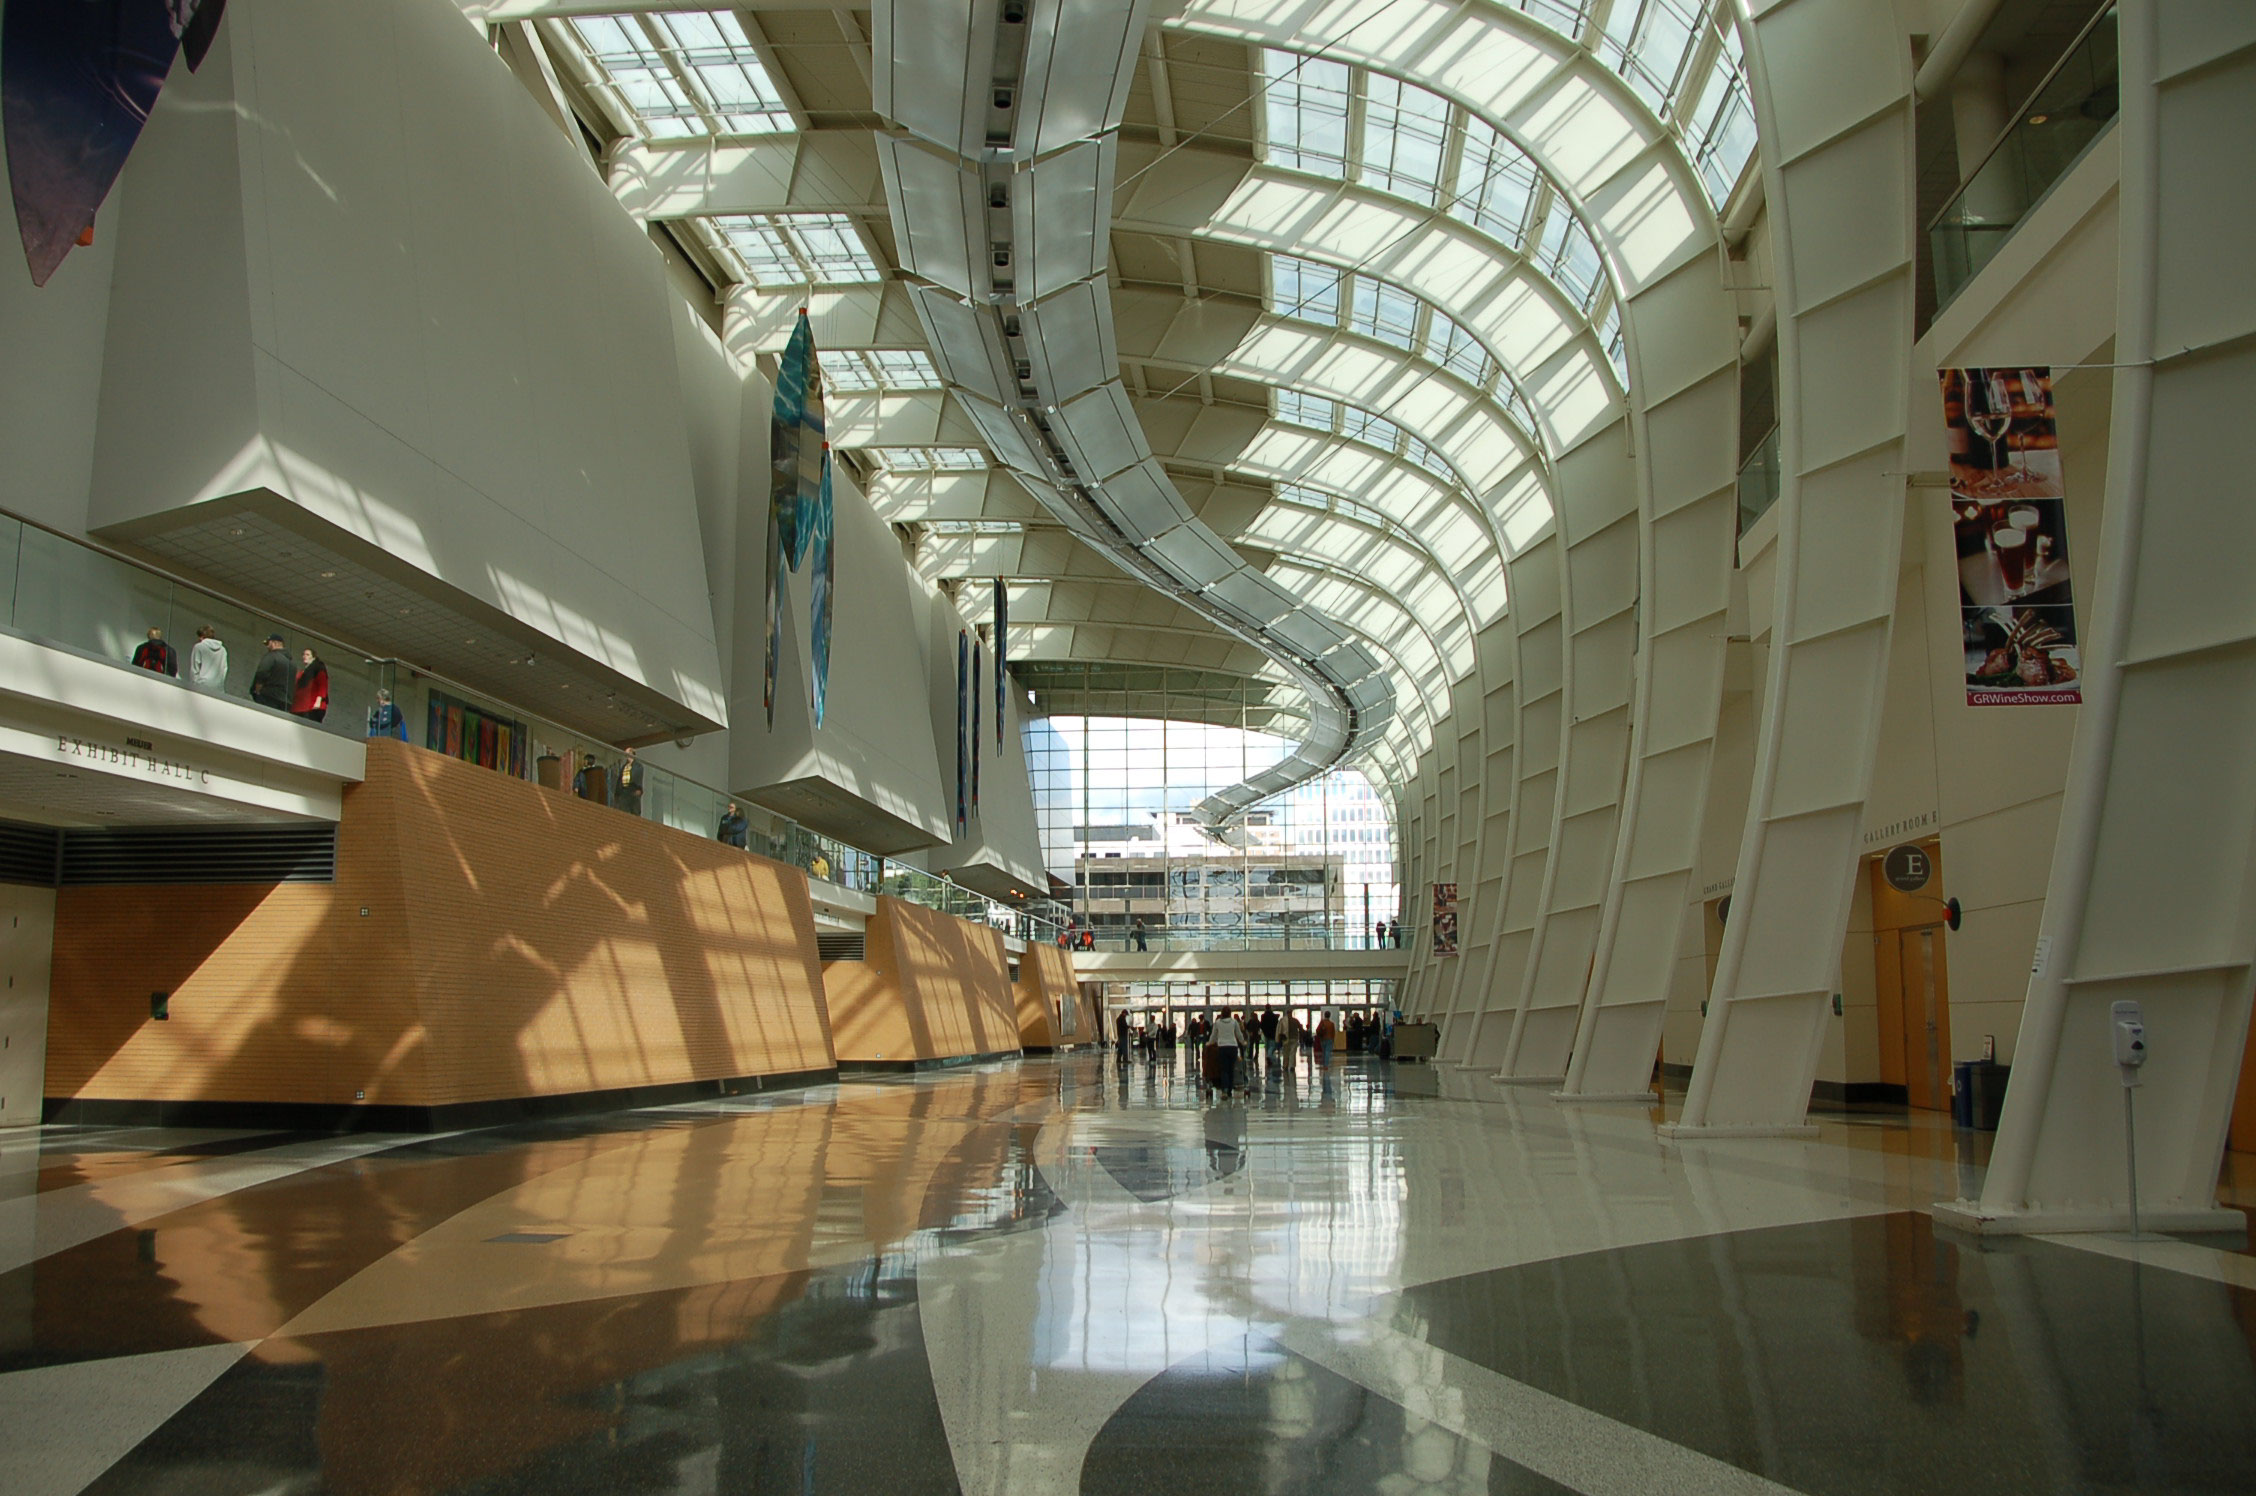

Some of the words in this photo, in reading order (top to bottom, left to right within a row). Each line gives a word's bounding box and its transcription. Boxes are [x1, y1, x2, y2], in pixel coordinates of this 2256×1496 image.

[1973, 693, 2075, 704] GRWineShow.com
[57, 736, 140, 768] EXHIBIT
[147, 756, 193, 780] HALL
[201, 769, 210, 784] C
[1863, 822, 1900, 844] GALLERY
[1903, 813, 1928, 832] ROOM
[1932, 810, 1937, 823] E
[1905, 854, 1923, 875] E
